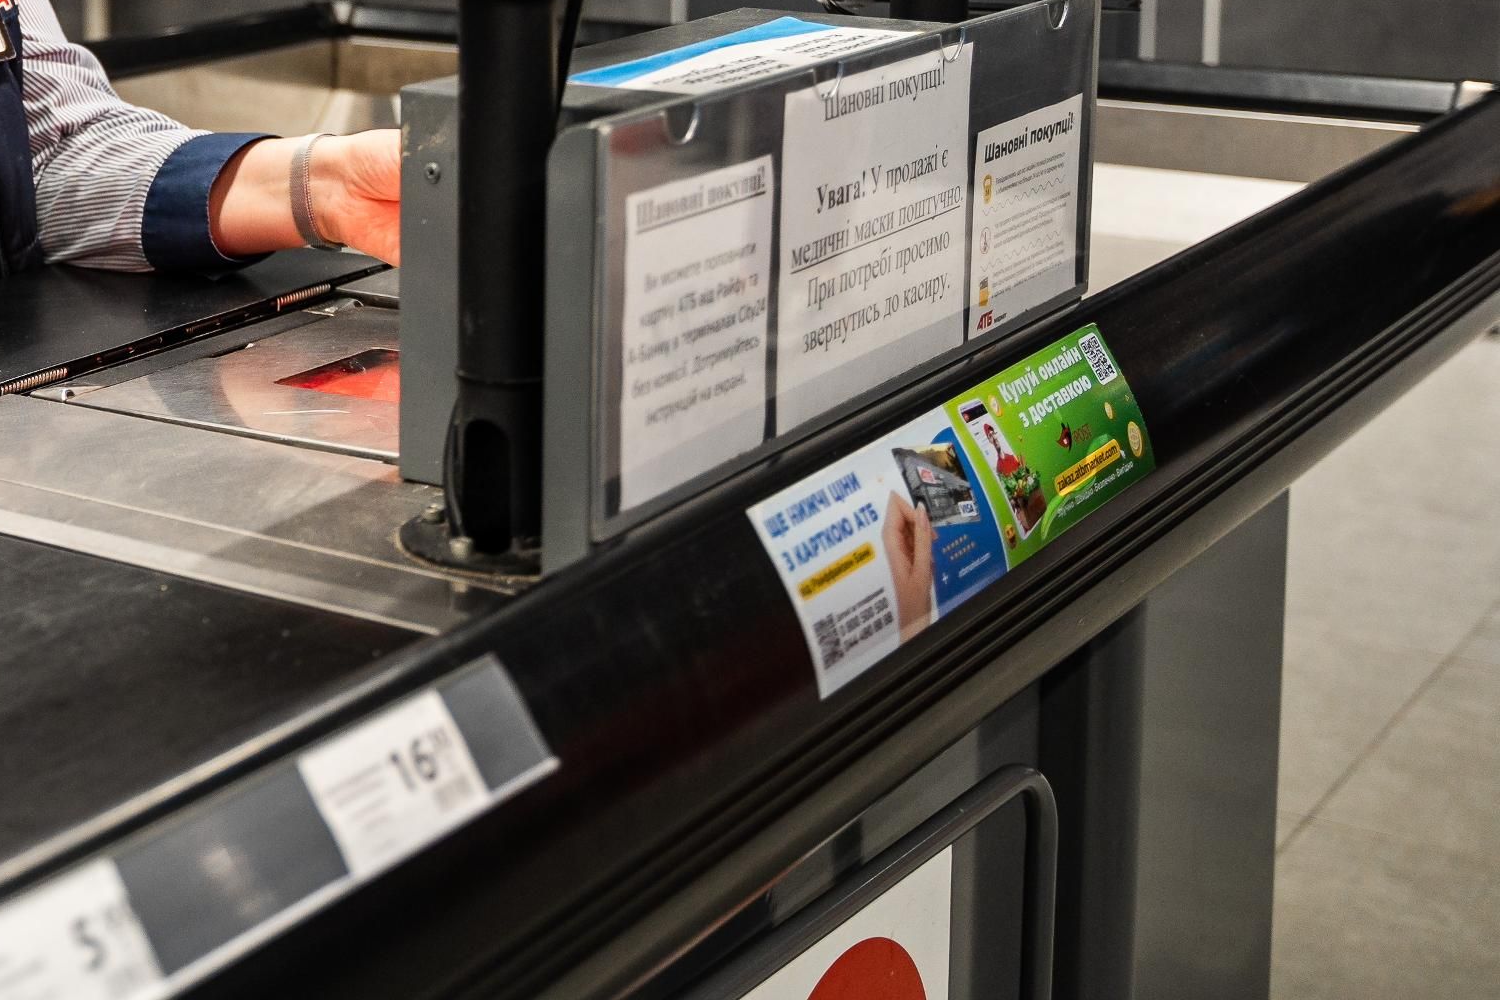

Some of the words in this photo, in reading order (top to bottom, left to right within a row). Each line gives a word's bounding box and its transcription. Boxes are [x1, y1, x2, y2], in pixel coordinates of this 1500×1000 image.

[822, 76, 884, 121] Шановні
[889, 58, 945, 101] покупці!
[984, 126, 1028, 163] Шановні
[1030, 112, 1074, 143] покупці!
[816, 170, 866, 214] Увага!
[871, 165, 882, 194] У
[886, 144, 938, 194] продажі
[941, 149, 949, 168] є
[791, 220, 849, 269] медичні
[854, 211, 894, 244] маски
[899, 185, 963, 227] поштучно.
[807, 276, 835, 310] При
[840, 246, 892, 291] потребі
[895, 231, 950, 274] просимо
[803, 303, 880, 353] звернутись
[884, 294, 899, 318] до
[903, 273, 950, 308] касиру.
[977, 310, 993, 330] АТБ
[997, 366, 1040, 403] Купуй
[1038, 345, 1083, 380] онлайн
[1018, 411, 1030, 428] з
[1028, 374, 1092, 425] доставкою
[1057, 445, 1118, 491] zakaz.atbmarket.com
[764, 511, 790, 538] ЩЕ
[781, 551, 795, 572] З
[794, 517, 854, 565] КАРТКОЮ
[853, 503, 879, 532] АТБ
